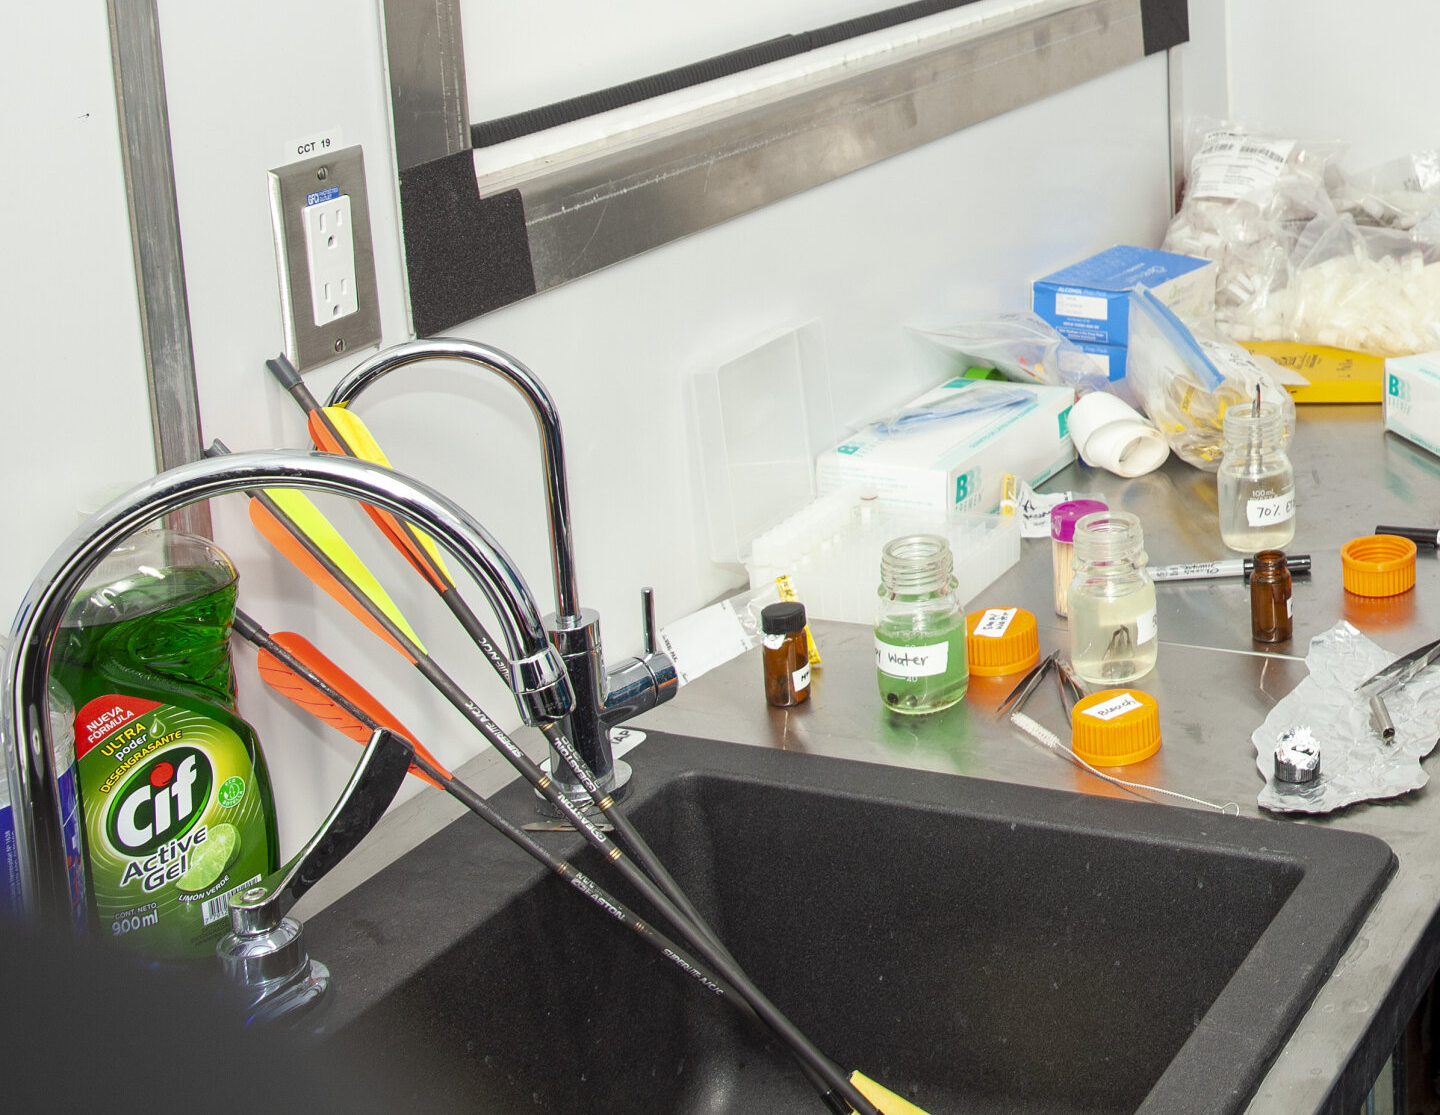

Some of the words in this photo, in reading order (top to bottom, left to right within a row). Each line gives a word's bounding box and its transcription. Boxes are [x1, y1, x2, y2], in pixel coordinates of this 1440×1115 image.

[297, 141, 316, 155] CCT
[320, 137, 332, 149] 19
[1257, 504, 1281, 518] 70%
[906, 675, 918, 684] 40
[85, 705, 124, 733] NUEVA
[1097, 699, 1136, 716] Bleach
[100, 721, 148, 759] ULTRA
[114, 733, 148, 762] poder
[486, 722, 525, 759] SUPERLITE
[99, 729, 183, 794] DESENGRASANTE
[554, 739, 587, 779] EASTON
[117, 754, 197, 848] Cif
[557, 790, 596, 831] EASTON
[119, 824, 208, 888] Active
[141, 853, 190, 893] Gel
[204, 874, 231, 899] VERDE
[137, 902, 157, 914] NETO
[583, 886, 626, 921] EASTON
[662, 947, 702, 979] SUPERLITE
